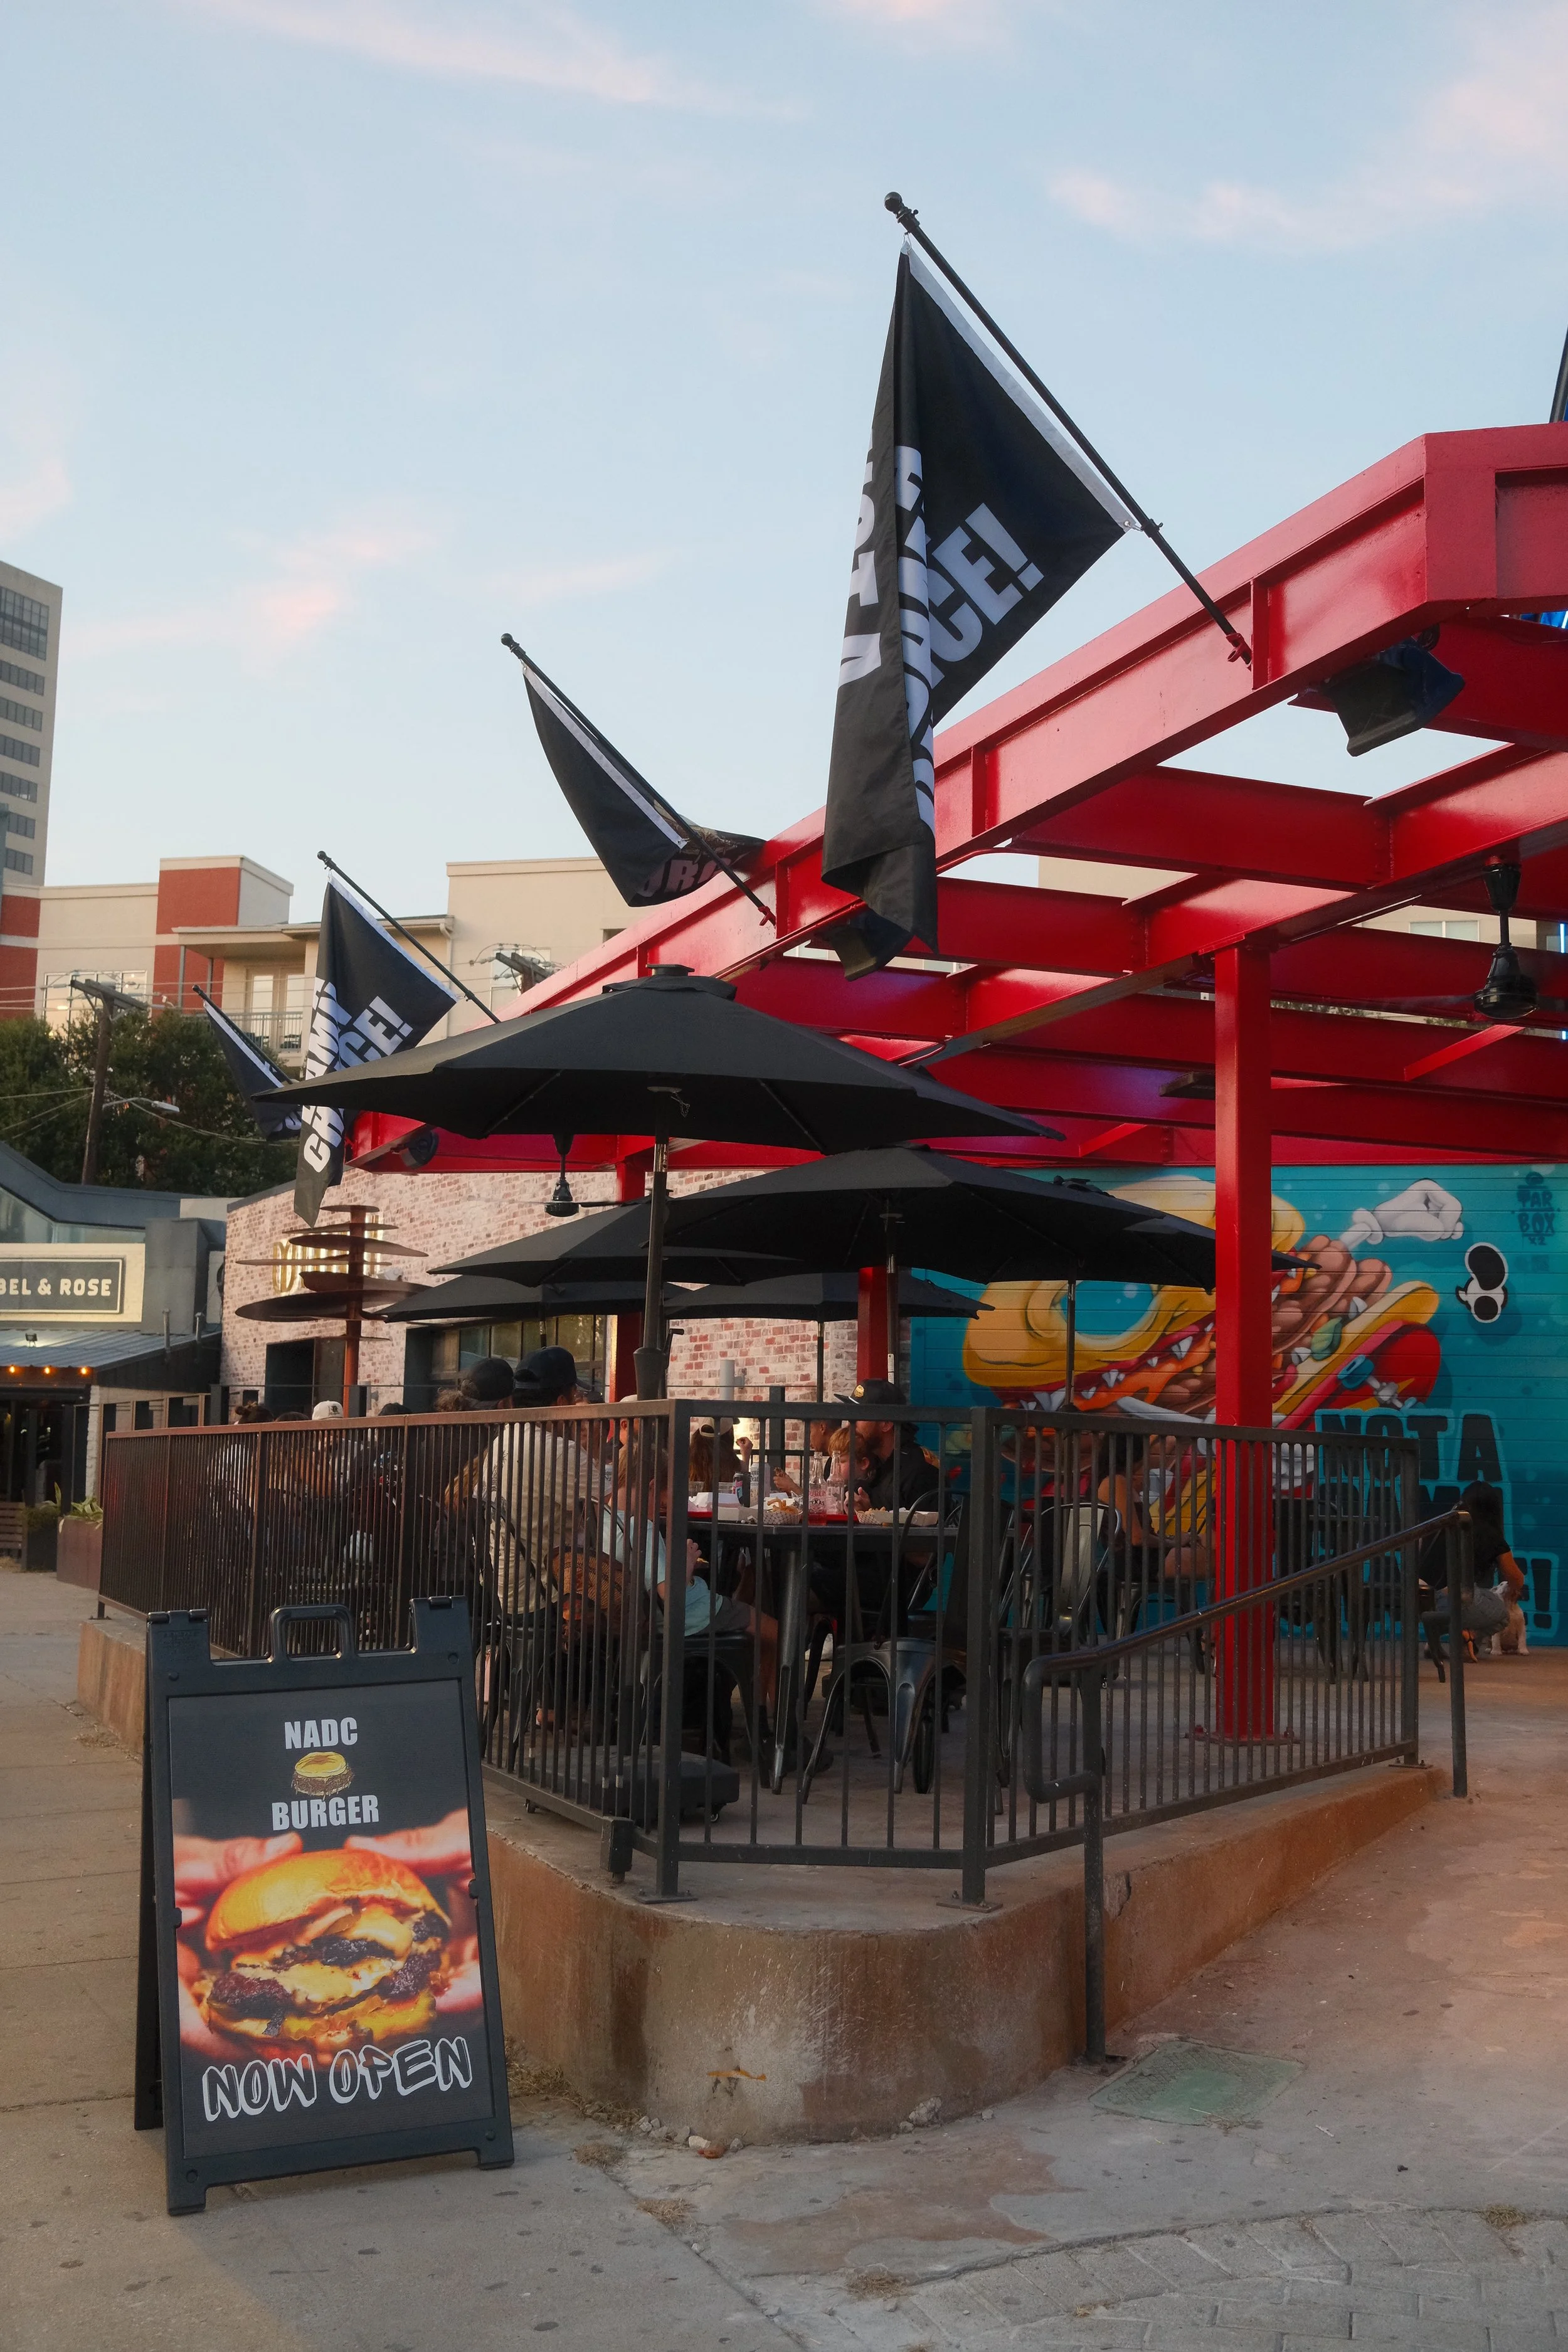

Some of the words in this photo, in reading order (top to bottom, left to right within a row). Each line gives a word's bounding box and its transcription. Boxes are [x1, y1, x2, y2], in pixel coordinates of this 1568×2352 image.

[1518, 1212, 1555, 1234] BOX
[38, 1278, 51, 1295] &
[60, 1278, 112, 1296] ROSE
[284, 1717, 358, 1749] NADC
[272, 1794, 379, 1831] BURGER
[202, 2053, 318, 2122] NOW
[329, 2036, 472, 2104] OPEN
